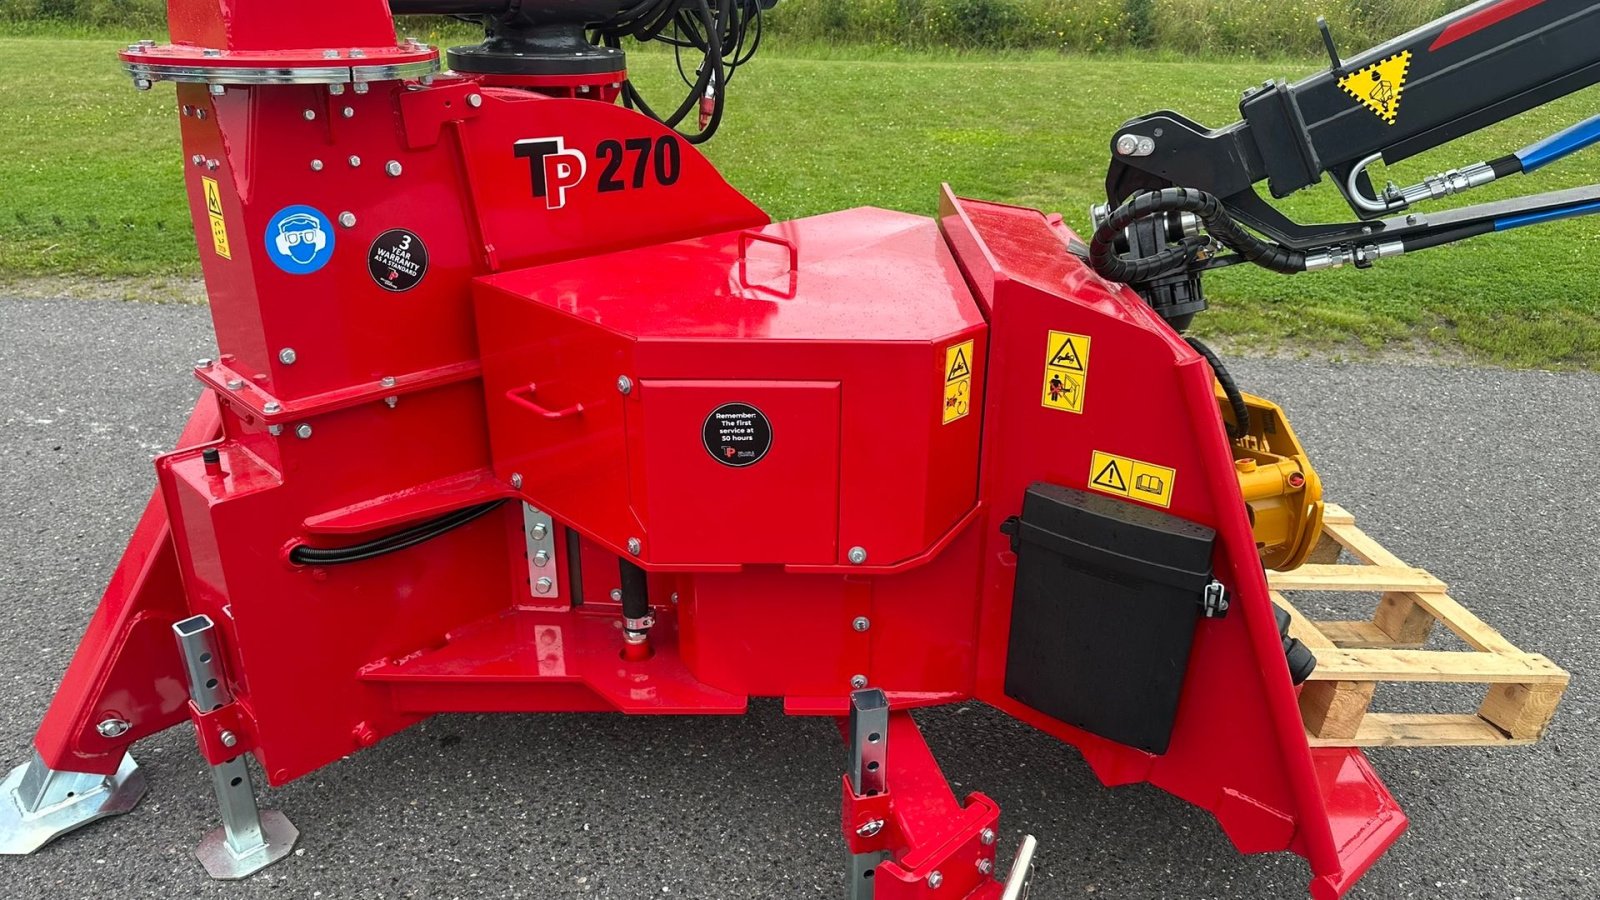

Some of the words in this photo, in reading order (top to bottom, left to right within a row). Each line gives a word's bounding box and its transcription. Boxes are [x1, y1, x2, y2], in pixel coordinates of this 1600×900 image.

[513, 136, 587, 210] TP
[595, 134, 681, 193] 270
[399, 235, 411, 250] 3
[377, 247, 420, 271] WARRANTY
[392, 246, 411, 260] YEAR
[387, 260, 417, 277] STANDARD
[721, 445, 736, 458] TP
